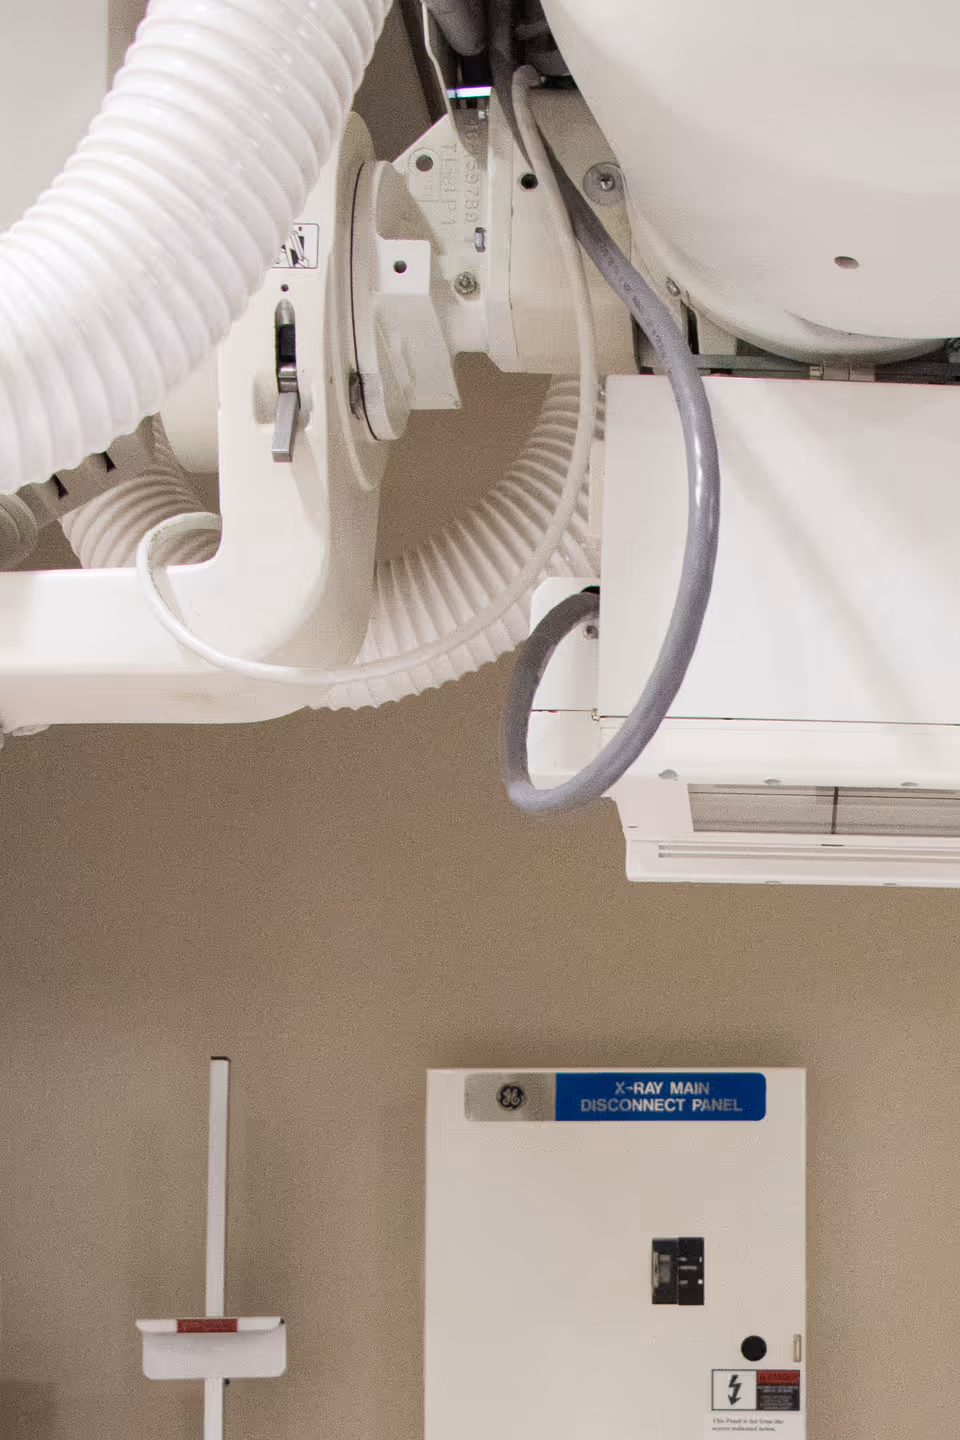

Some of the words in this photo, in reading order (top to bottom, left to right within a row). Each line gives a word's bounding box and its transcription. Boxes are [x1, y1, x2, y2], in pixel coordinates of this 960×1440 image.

[614, 1081, 663, 1095] X-RAY
[670, 1081, 710, 1095] MAIN
[580, 1098, 686, 1112] DISCONNECT
[691, 1098, 743, 1112] PANEL
